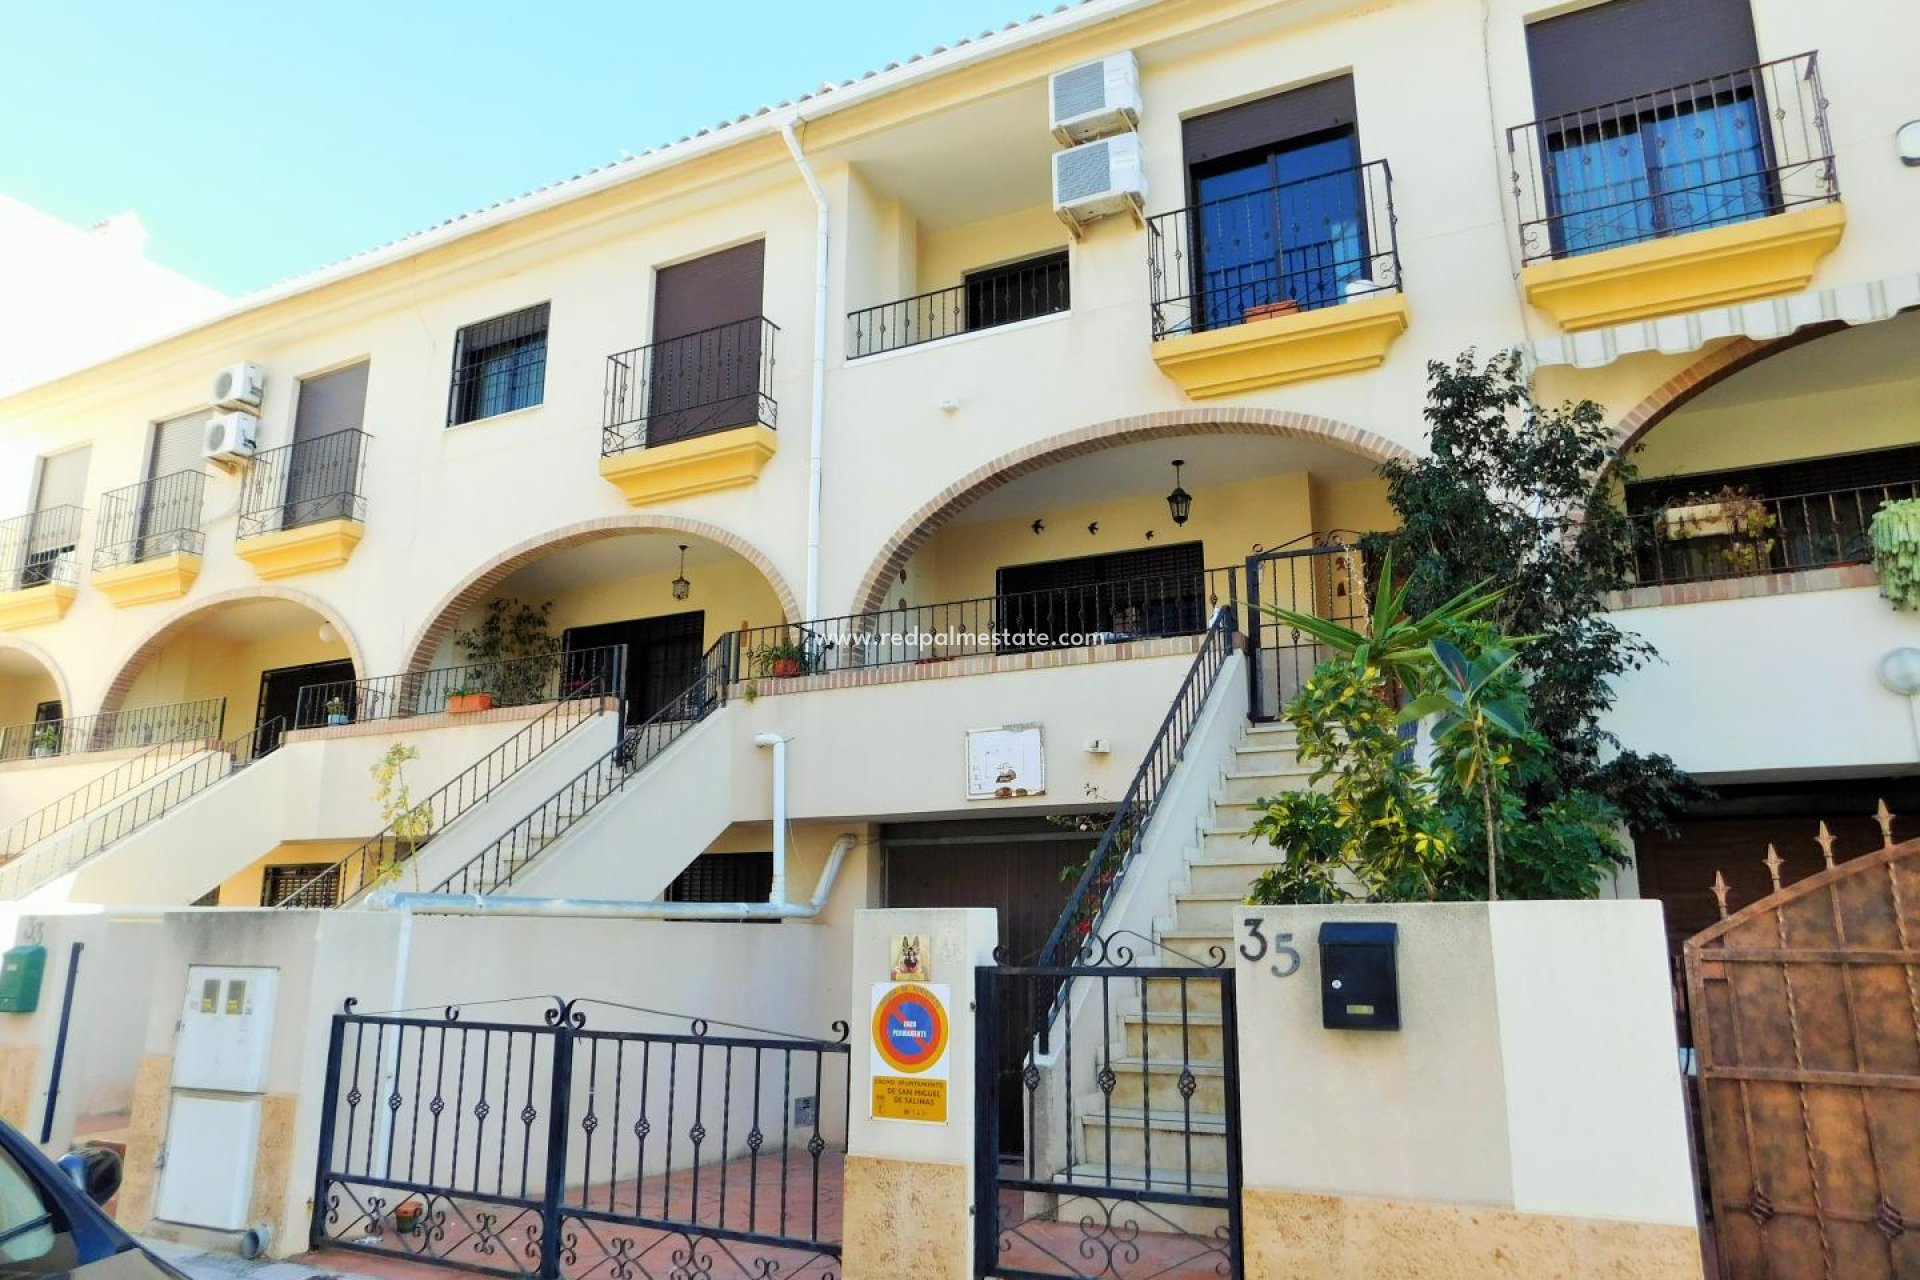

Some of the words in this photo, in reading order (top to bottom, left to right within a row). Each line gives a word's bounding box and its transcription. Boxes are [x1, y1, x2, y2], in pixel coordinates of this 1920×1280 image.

[1239, 918, 1300, 978] 35
[914, 1089, 941, 1098] MIGUEL
[904, 1096, 935, 1106] SALINAS
